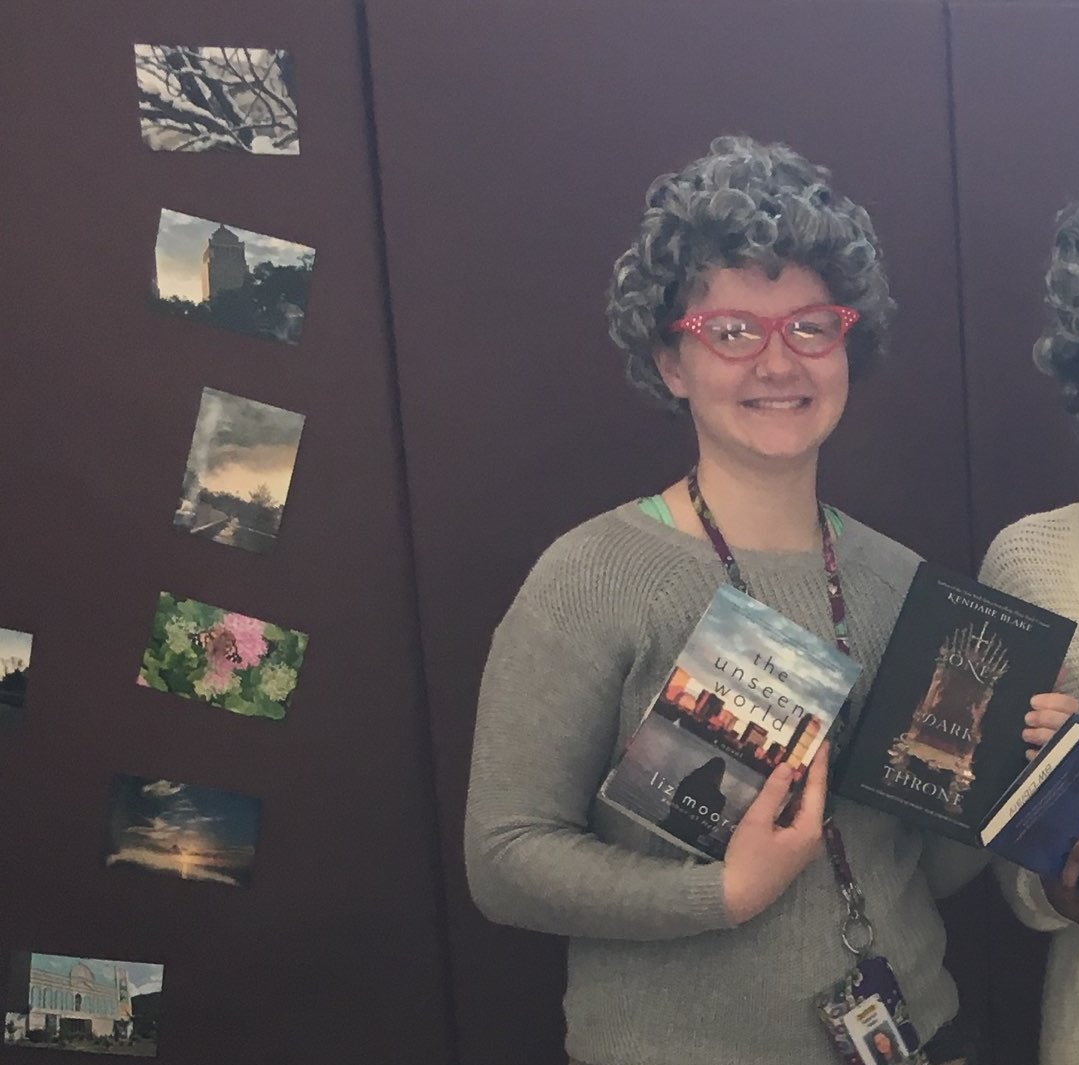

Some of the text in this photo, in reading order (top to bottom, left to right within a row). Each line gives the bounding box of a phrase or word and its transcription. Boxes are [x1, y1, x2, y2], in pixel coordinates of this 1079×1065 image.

[947, 592, 998, 620] KENDARE
[999, 612, 1034, 633] BLAKE
[713, 656, 806, 719] unseen
[753, 652, 789, 683] the
[713, 680, 788, 732] world
[921, 712, 973, 742] DARK
[650, 771, 676, 795] liz
[883, 766, 964, 808] THRONE
